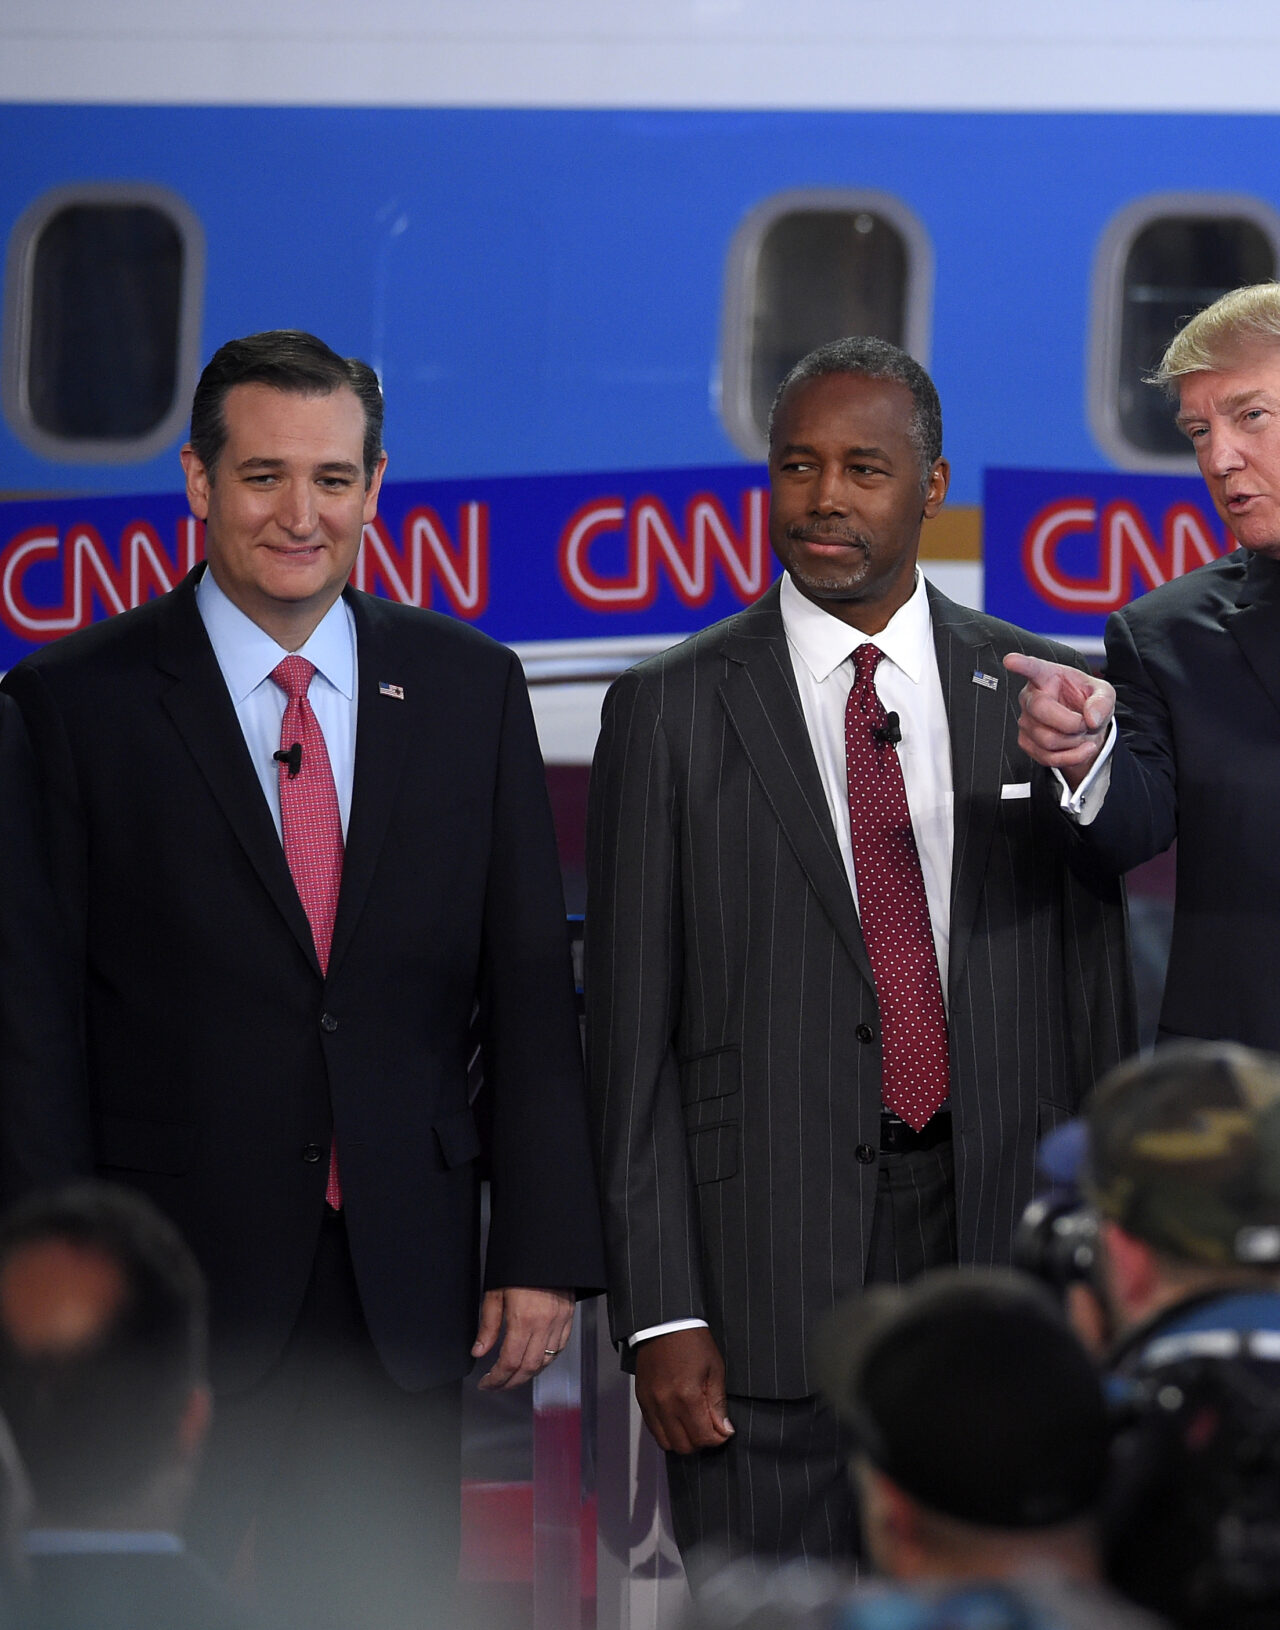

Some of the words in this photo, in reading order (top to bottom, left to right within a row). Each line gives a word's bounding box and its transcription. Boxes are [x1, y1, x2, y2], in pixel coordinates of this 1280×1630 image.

[0, 519, 206, 643] CNN
[349, 502, 488, 620] NN
[557, 488, 771, 612] CNN
